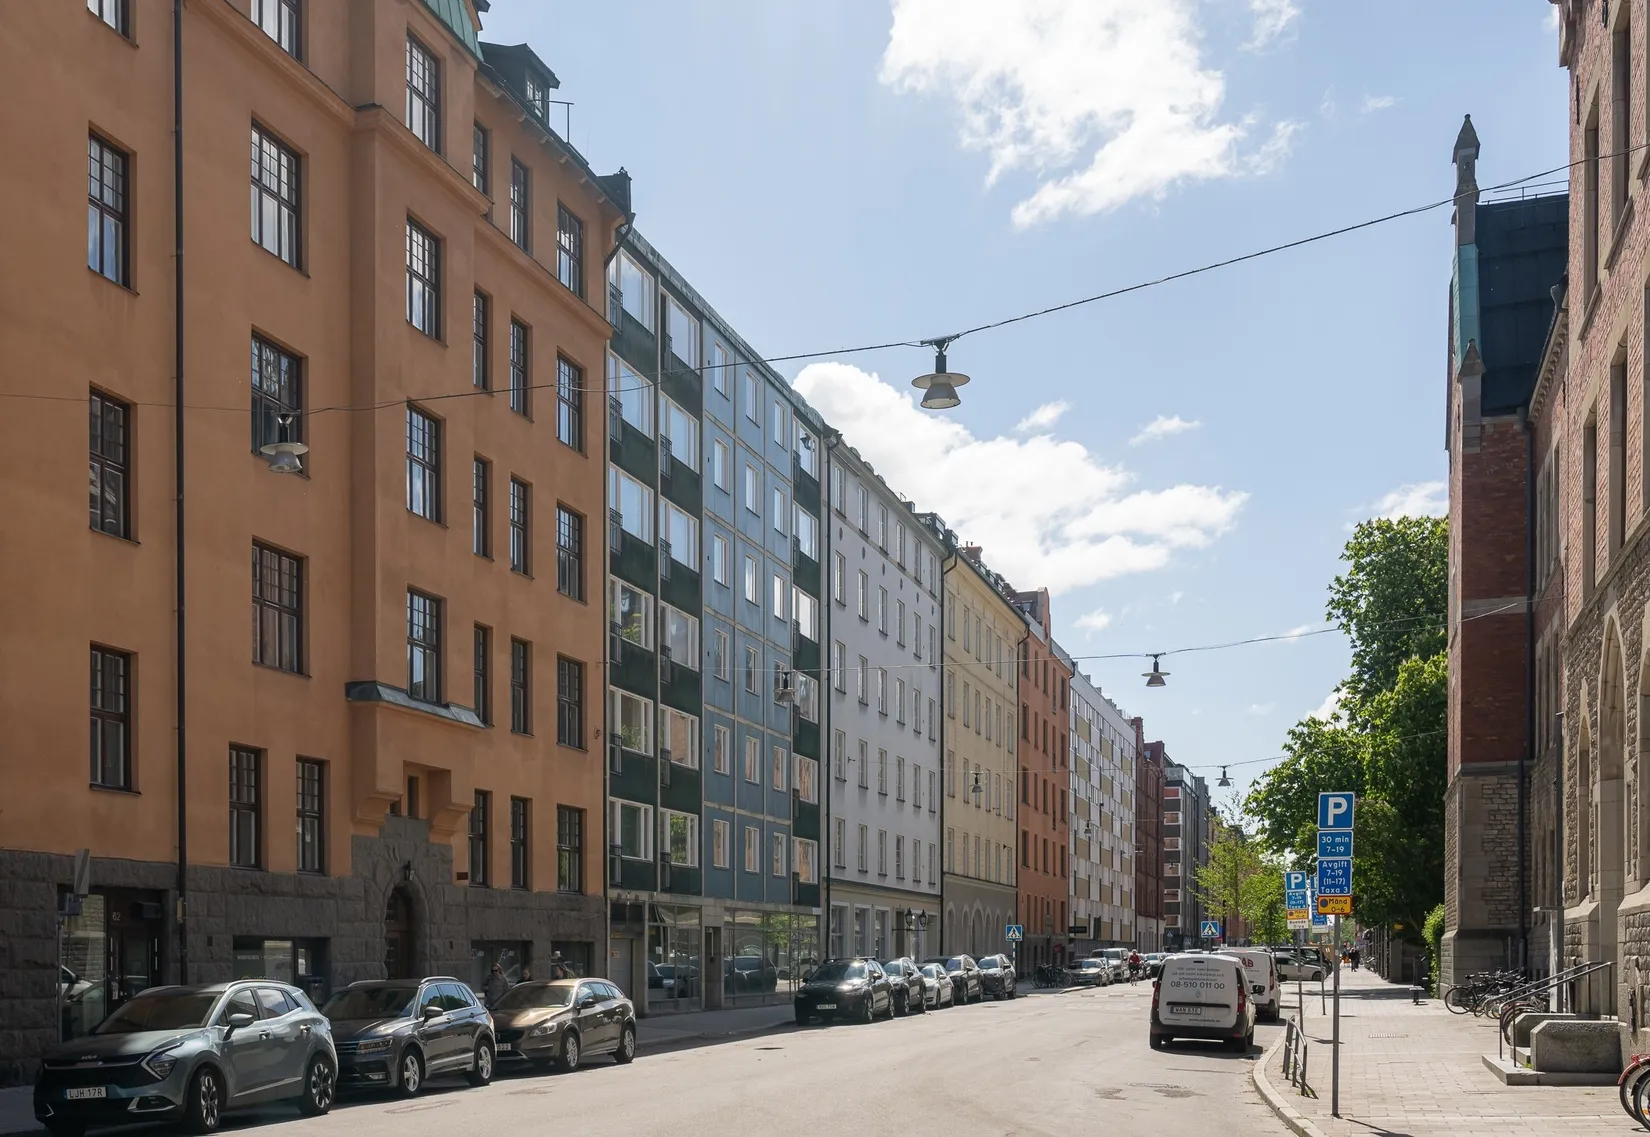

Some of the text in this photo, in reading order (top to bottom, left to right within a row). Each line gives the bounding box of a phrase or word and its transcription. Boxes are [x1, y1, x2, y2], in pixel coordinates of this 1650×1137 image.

[1328, 797, 1348, 826] P
[1322, 861, 1348, 869] Avgift
[1290, 873, 1303, 889] P
[1323, 877, 1346, 885] (11-17)
[1320, 886, 1349, 894] Taxa 3
[112, 911, 121, 921] 62
[1170, 980, 1226, 990] 08-510 011 00
[69, 1088, 103, 1098] LJH 17R
